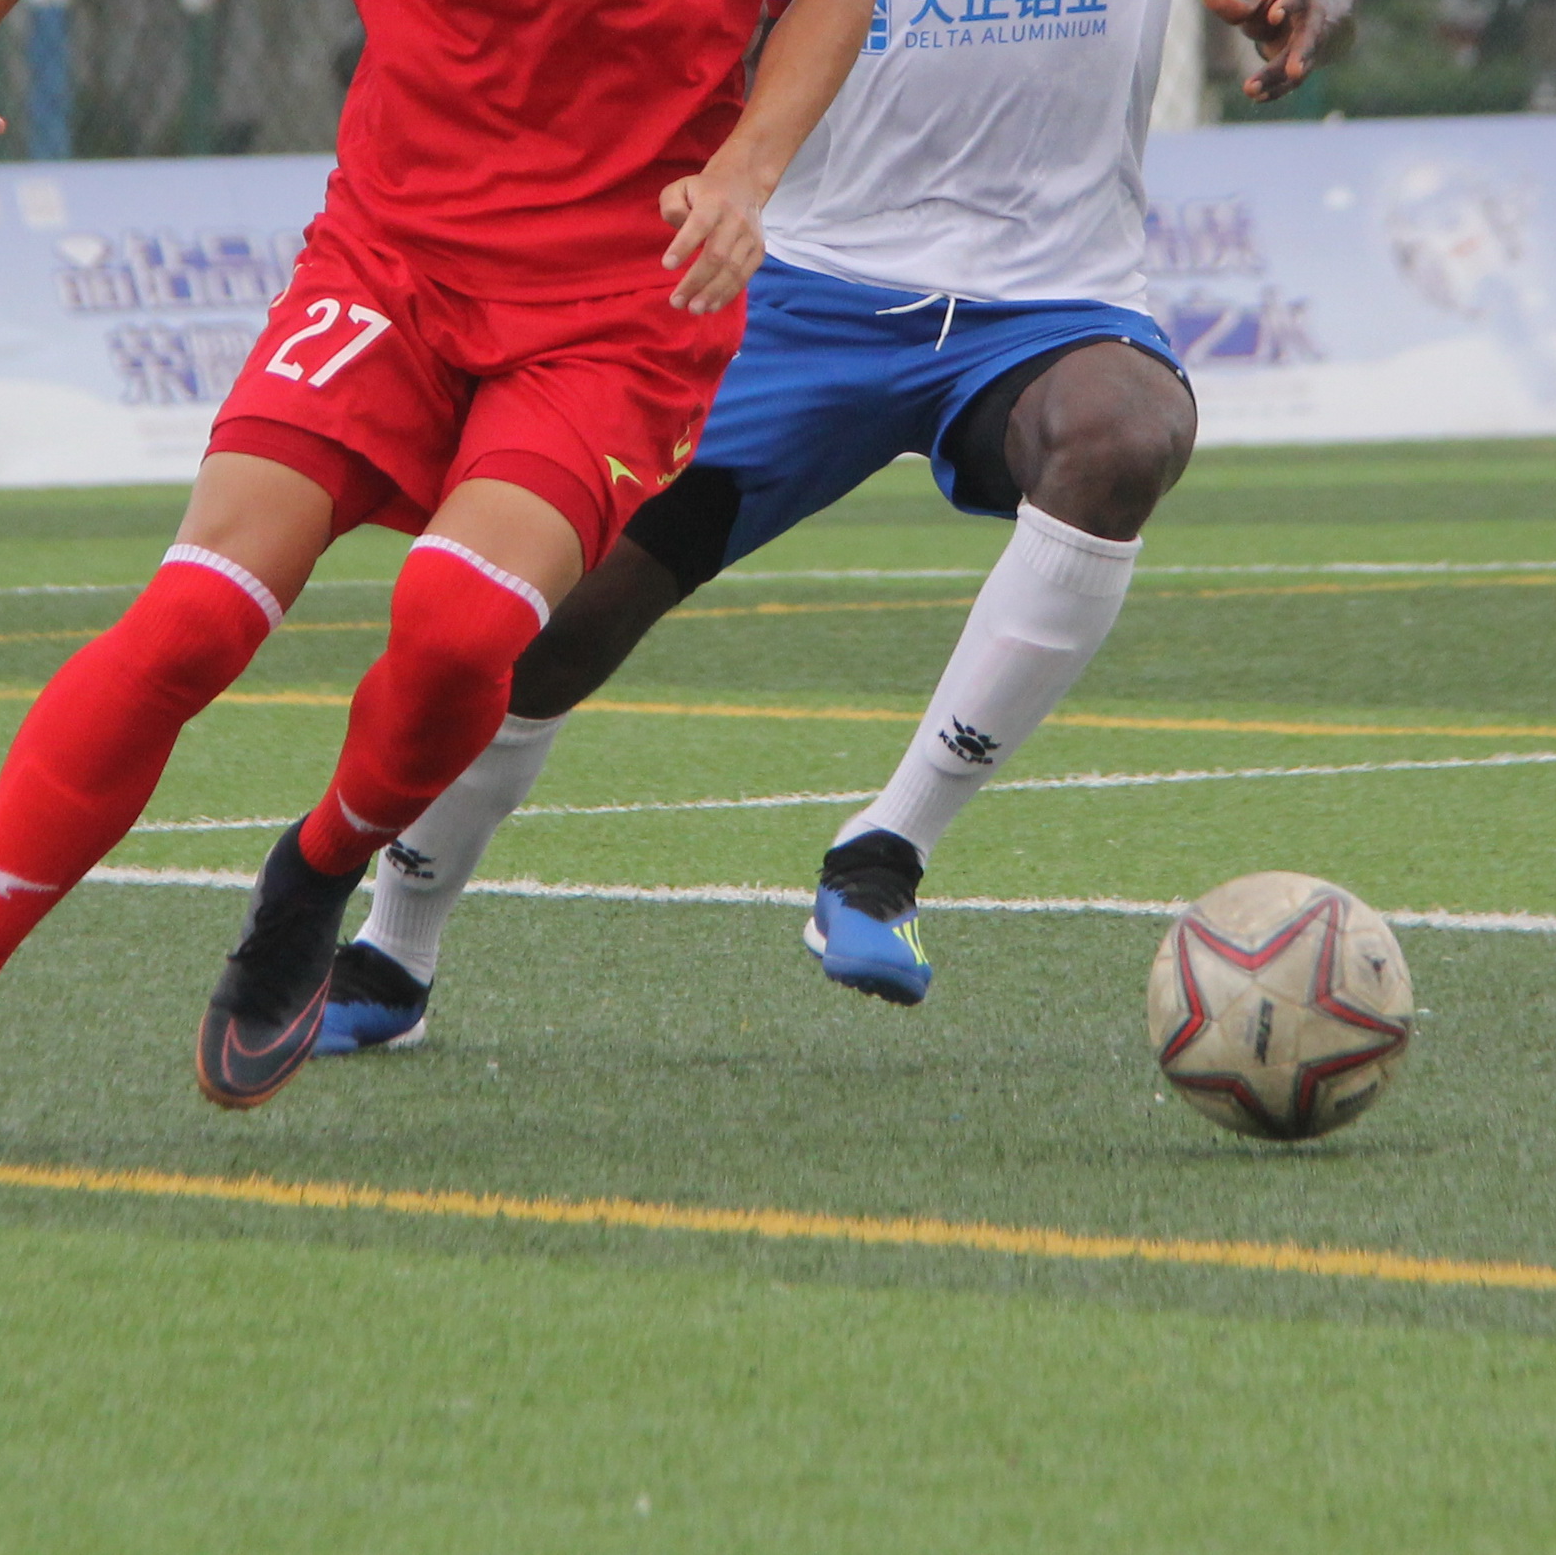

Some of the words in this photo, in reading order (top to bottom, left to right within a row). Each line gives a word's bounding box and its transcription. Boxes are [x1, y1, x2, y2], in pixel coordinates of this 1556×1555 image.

[905, 28, 973, 49] DELTA
[981, 18, 1107, 44] ALUMINIUM
[264, 297, 393, 389] 27
